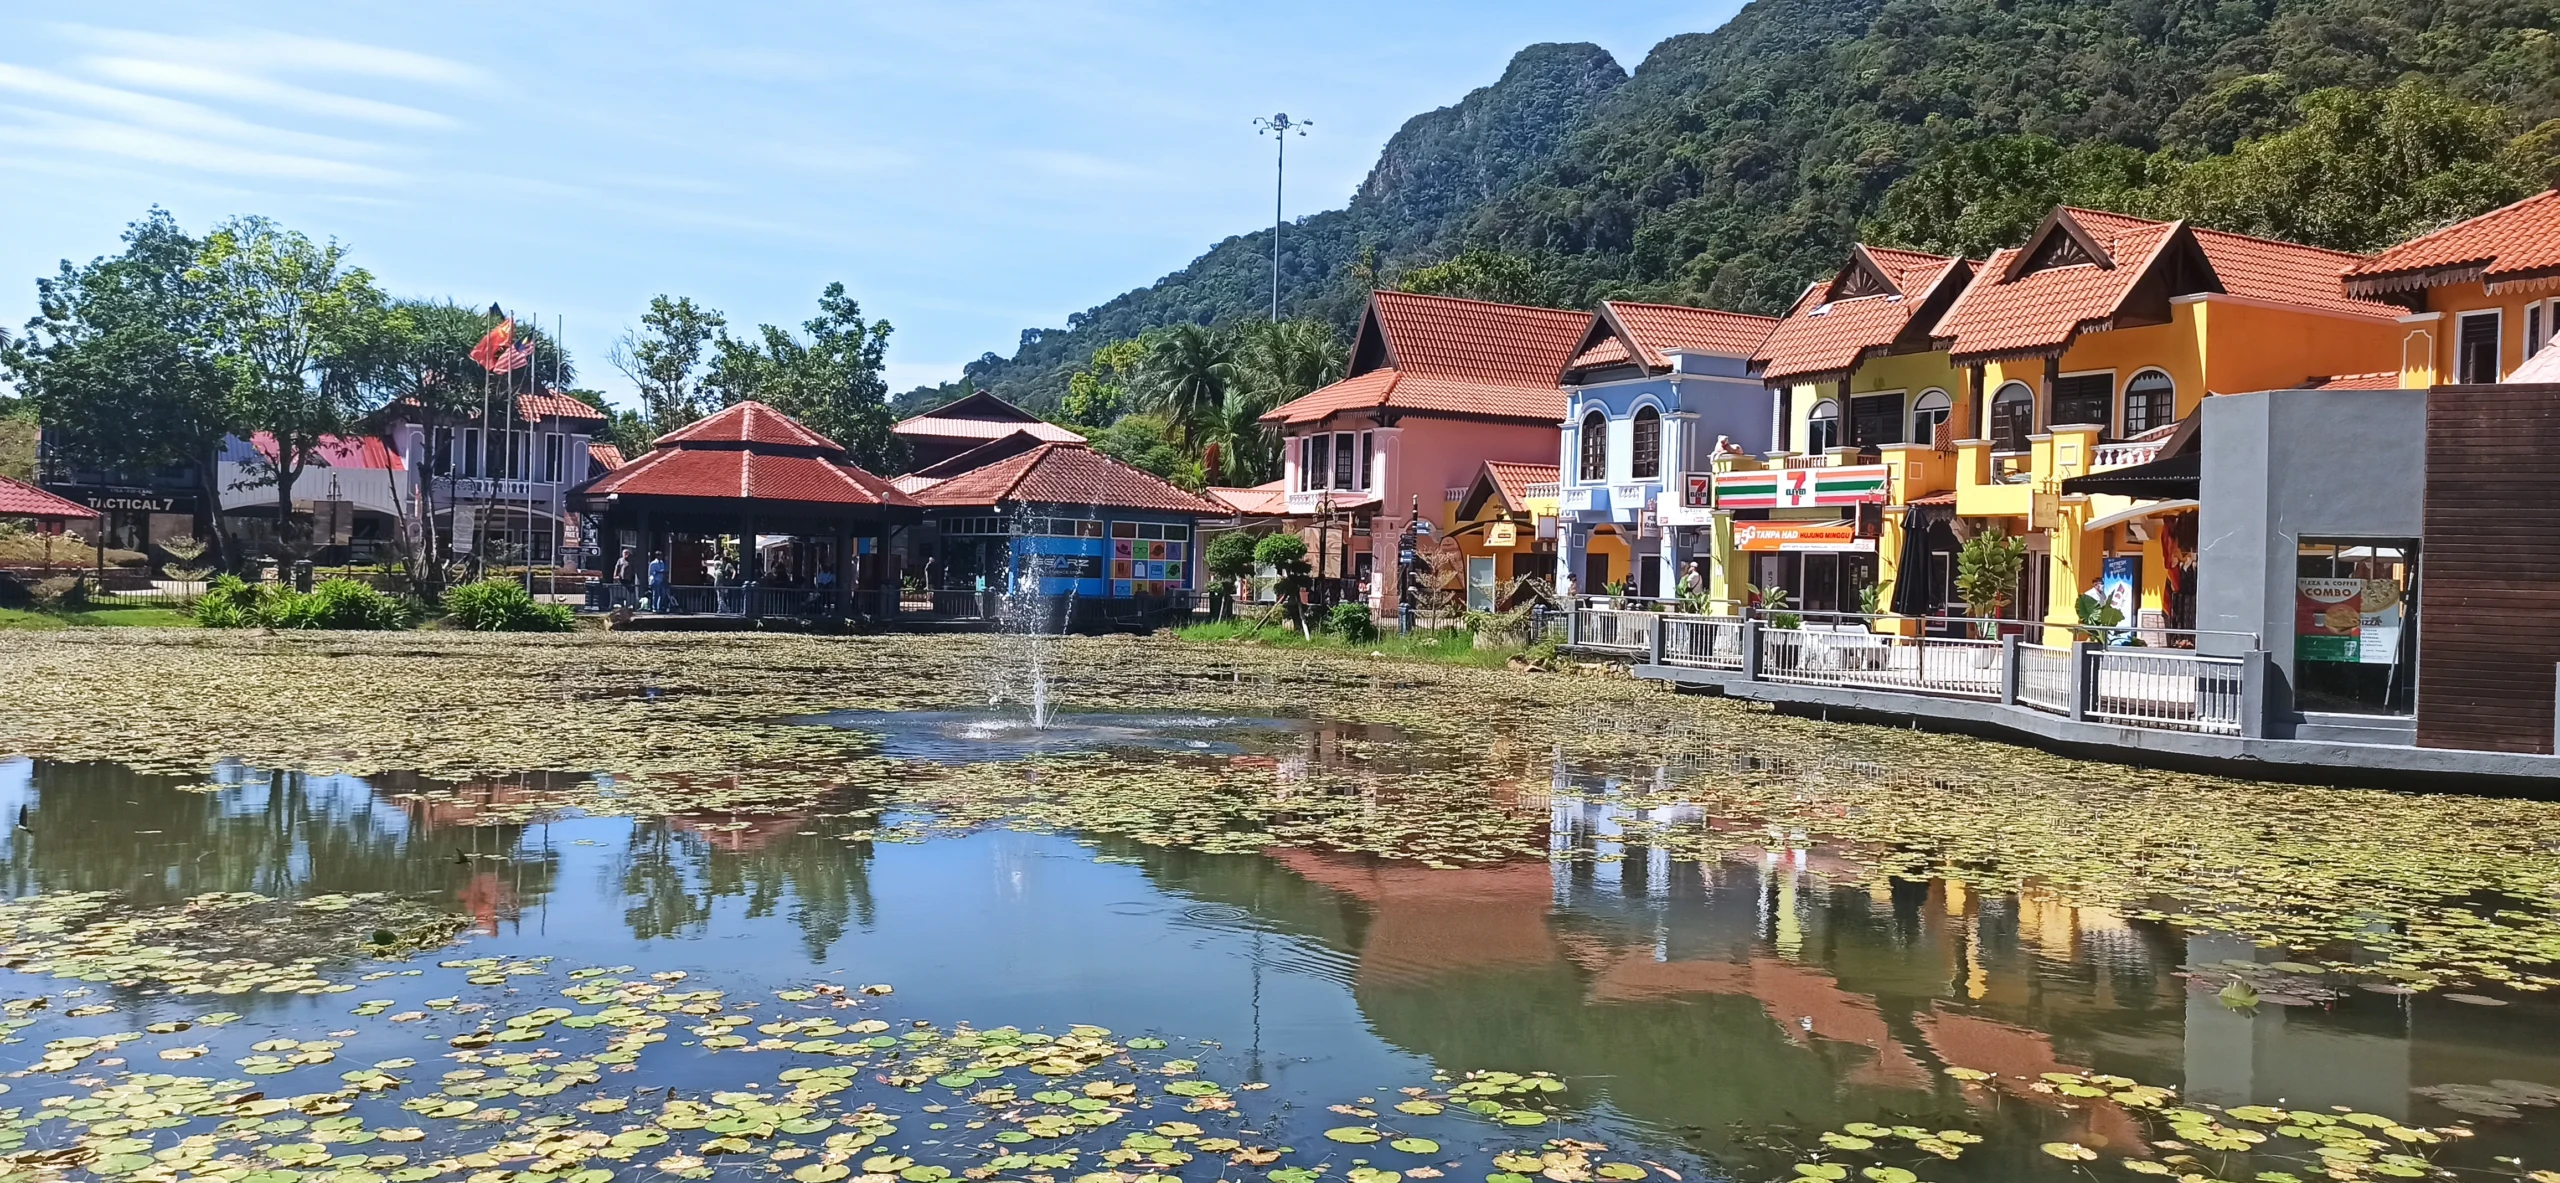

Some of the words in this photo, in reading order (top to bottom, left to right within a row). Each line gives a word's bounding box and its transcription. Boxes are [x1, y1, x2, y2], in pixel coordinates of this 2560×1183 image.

[1690, 479, 1707, 506] 7
[1787, 471, 1806, 506] 7
[88, 498, 161, 510] TACTICAL
[164, 498, 174, 510] 7
[1740, 525, 1756, 545] 5G
[1756, 530, 1781, 539] TANPA
[2305, 588, 2351, 596] COMBO
